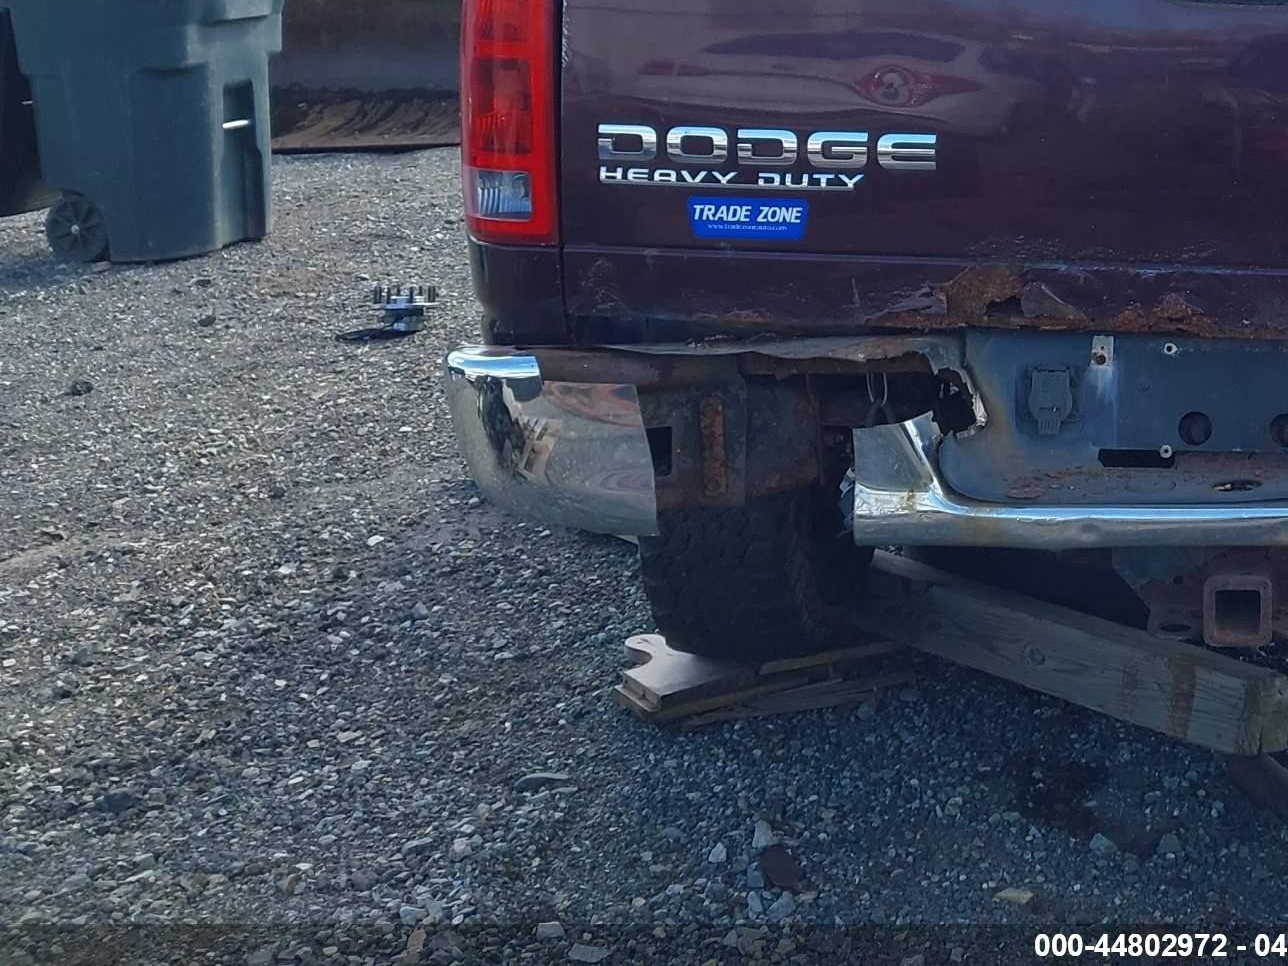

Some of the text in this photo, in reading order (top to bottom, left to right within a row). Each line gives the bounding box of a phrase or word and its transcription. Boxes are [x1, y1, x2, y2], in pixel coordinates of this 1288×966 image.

[598, 124, 936, 170] DODGE
[600, 166, 864, 188] HEAVY DUTY
[693, 204, 803, 222] TRADE ZONE
